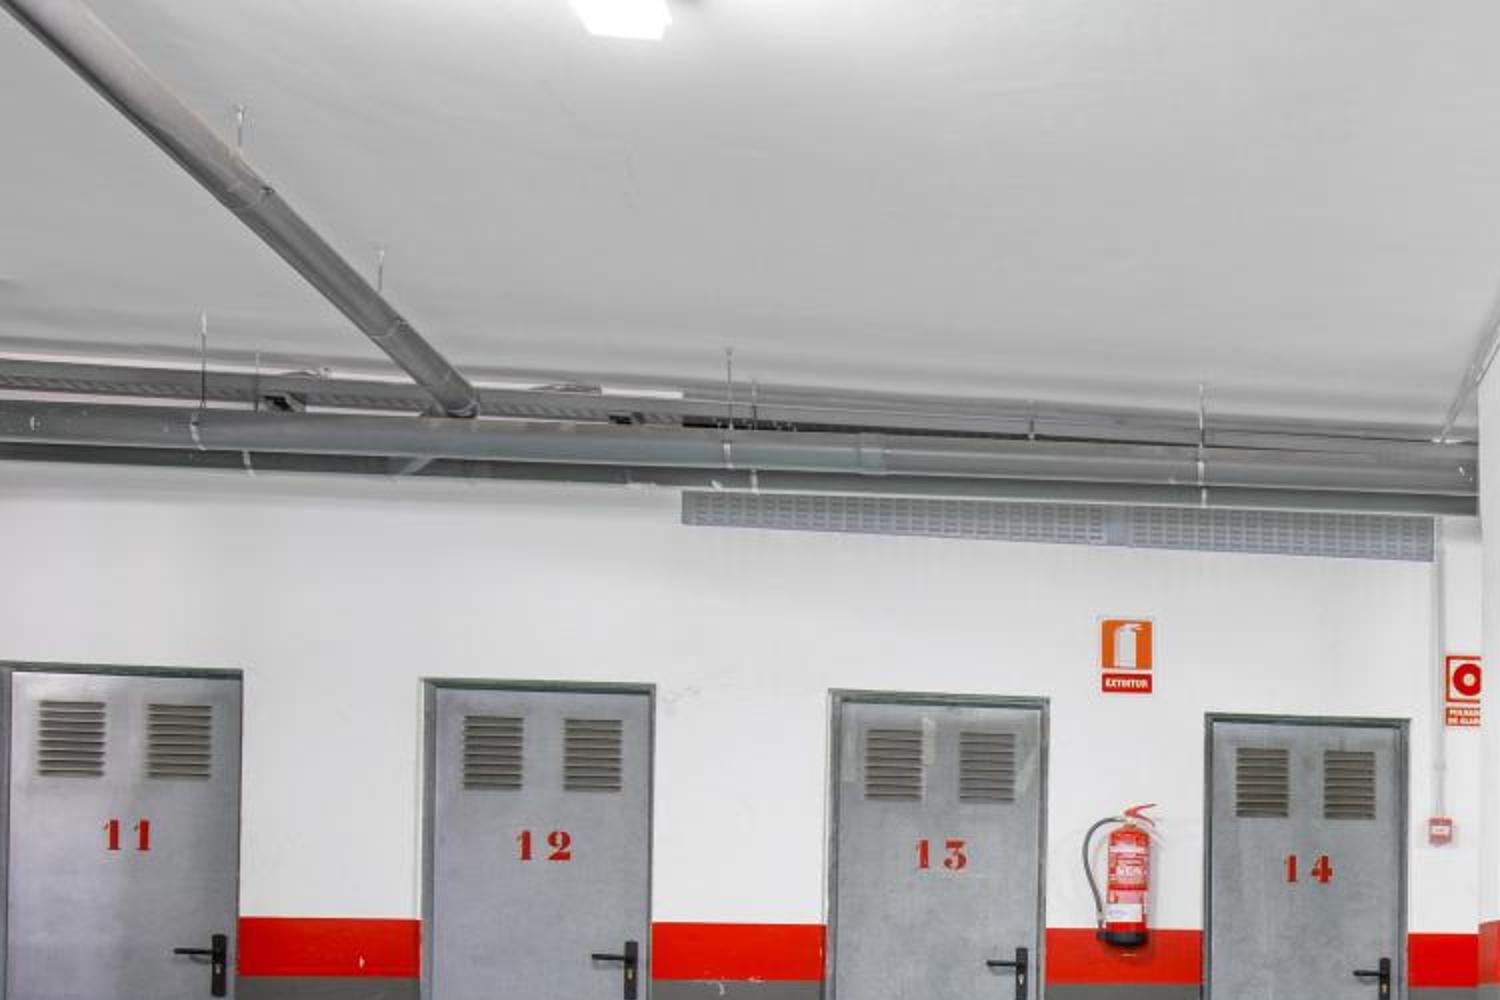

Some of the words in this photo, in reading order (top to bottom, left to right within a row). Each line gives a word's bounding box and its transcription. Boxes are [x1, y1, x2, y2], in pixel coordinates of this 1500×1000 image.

[103, 818, 152, 853] 11
[517, 830, 573, 862] 12
[915, 838, 968, 871] 13
[1284, 854, 1334, 884] 14
